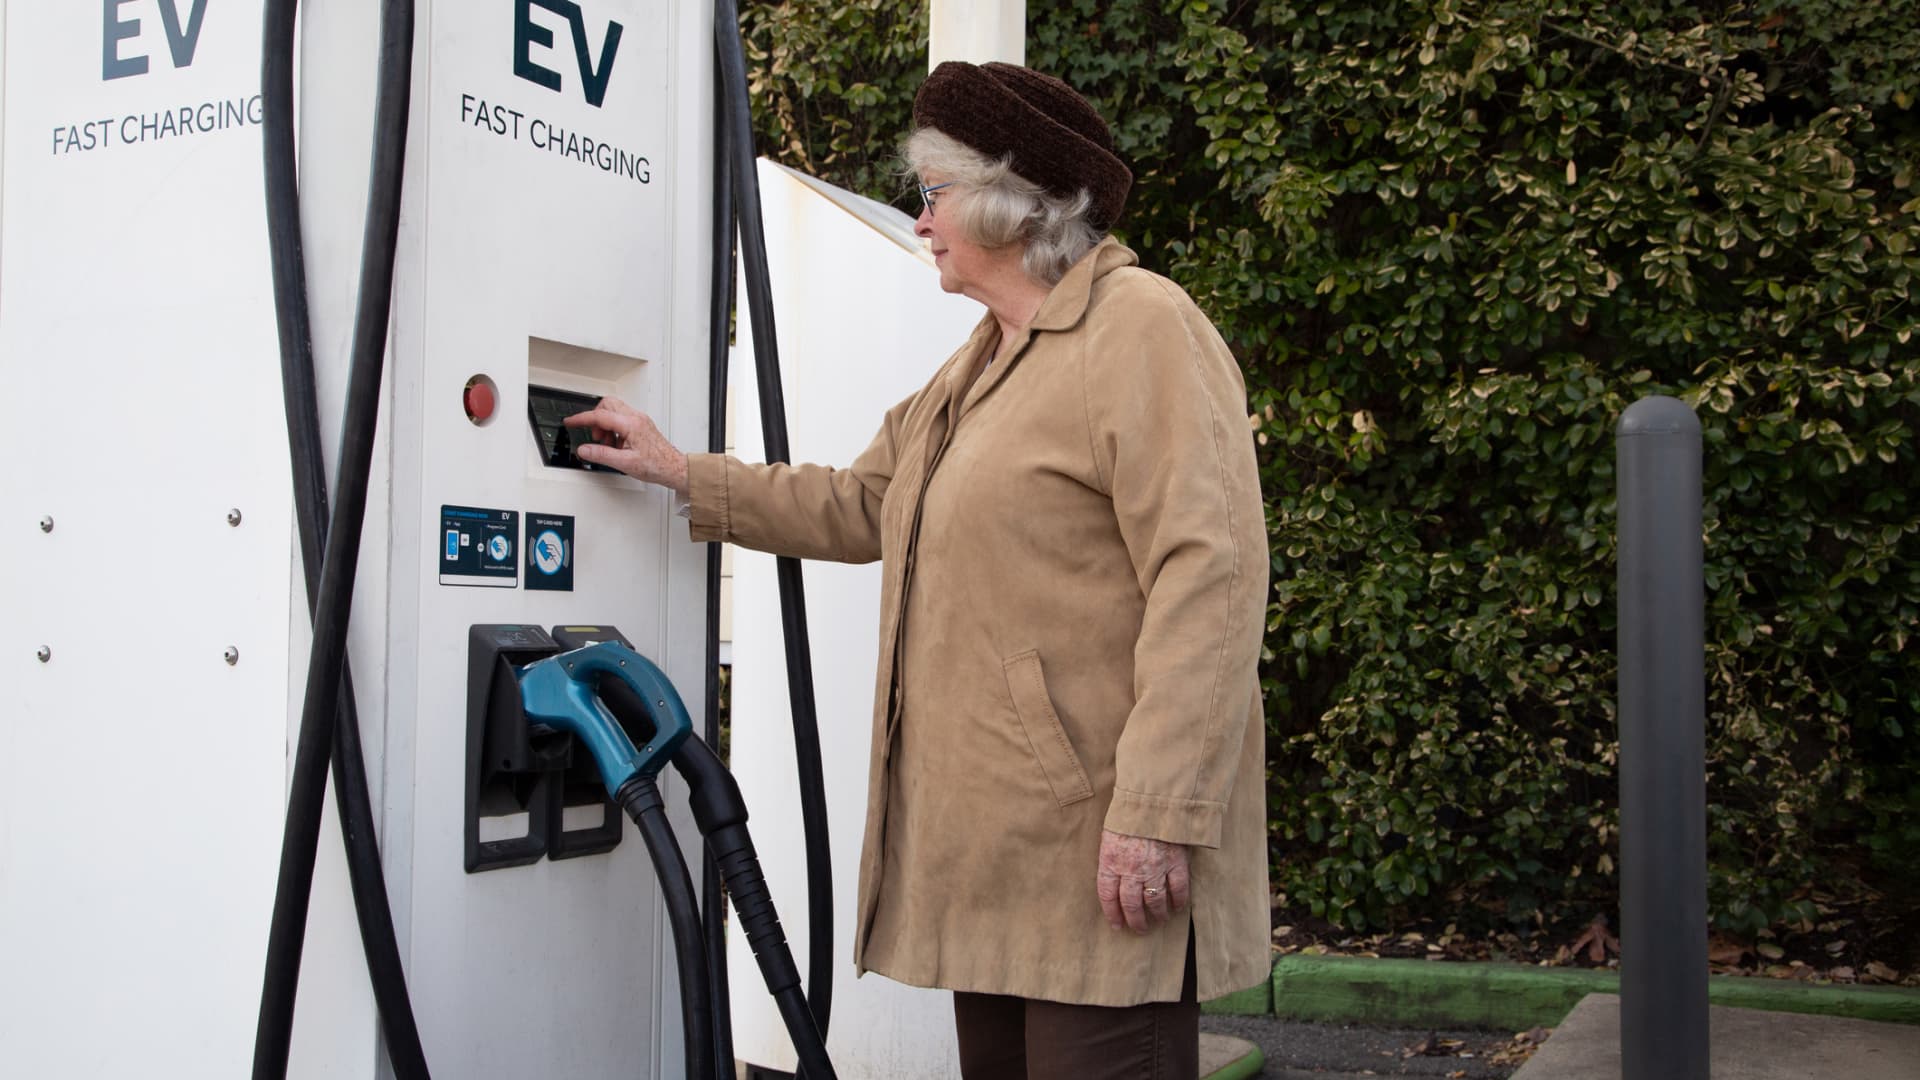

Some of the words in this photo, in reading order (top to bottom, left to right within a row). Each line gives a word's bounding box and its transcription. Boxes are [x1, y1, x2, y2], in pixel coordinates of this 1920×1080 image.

[102, 0, 209, 81] EV
[513, 0, 624, 109] EV
[53, 119, 115, 155] FAST
[120, 94, 263, 145] CHARGING
[461, 93, 524, 140] FAST
[530, 119, 650, 184] CHARGING
